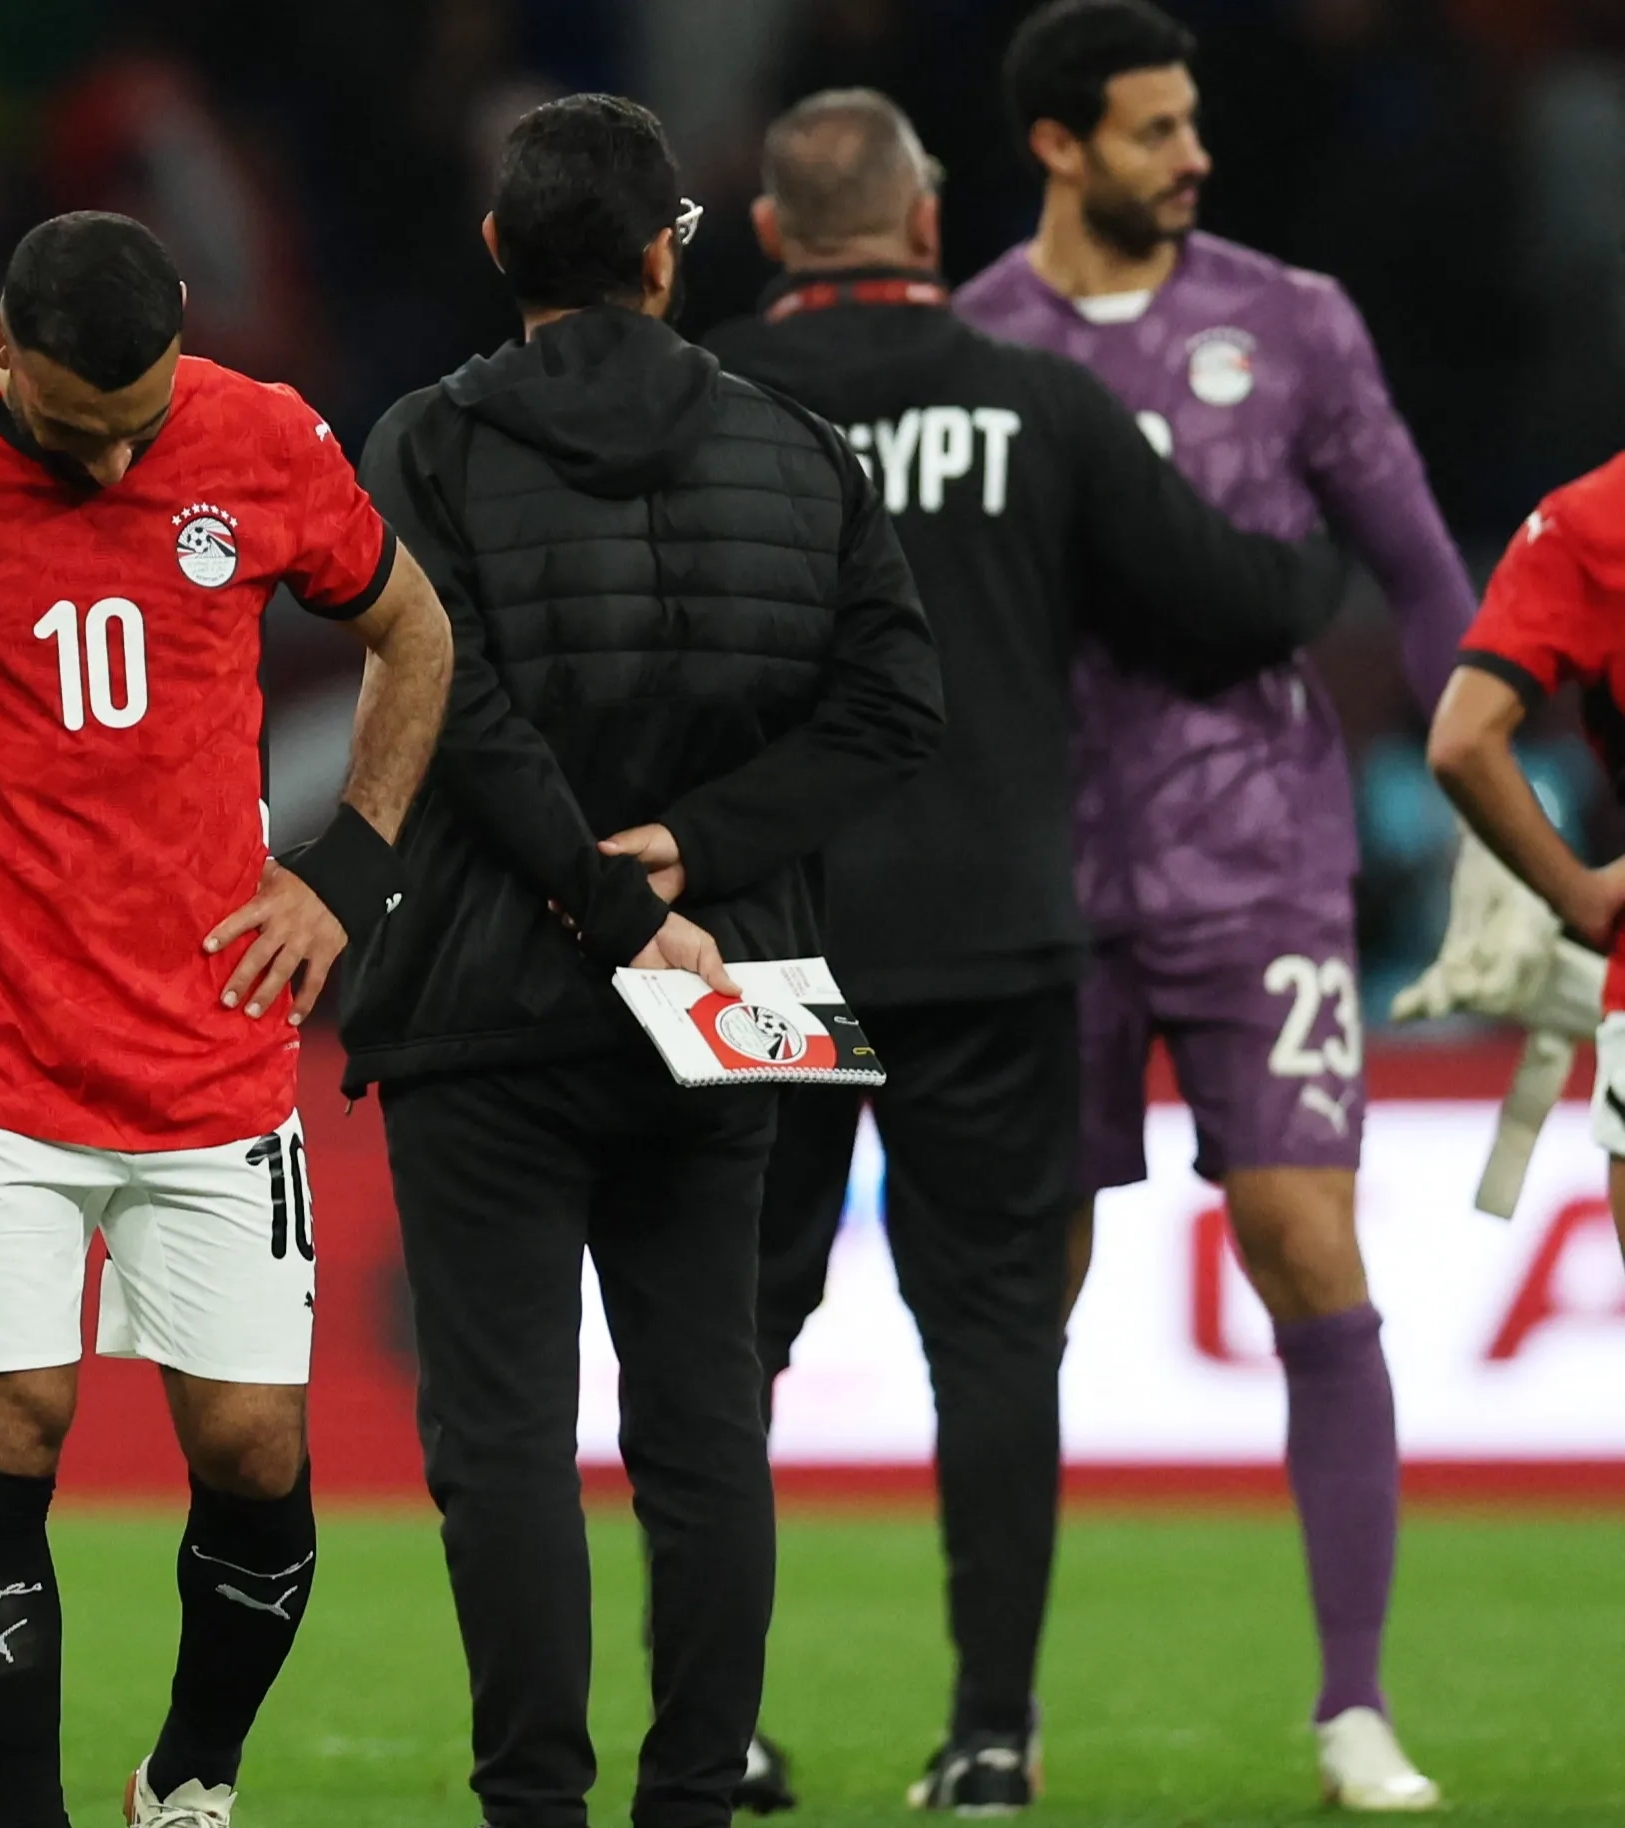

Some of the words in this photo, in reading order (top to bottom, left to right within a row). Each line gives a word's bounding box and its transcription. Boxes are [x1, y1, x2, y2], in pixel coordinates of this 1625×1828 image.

[33, 597, 148, 732] 10
[1263, 955, 1363, 1078] 23
[245, 1131, 314, 1262] 10
